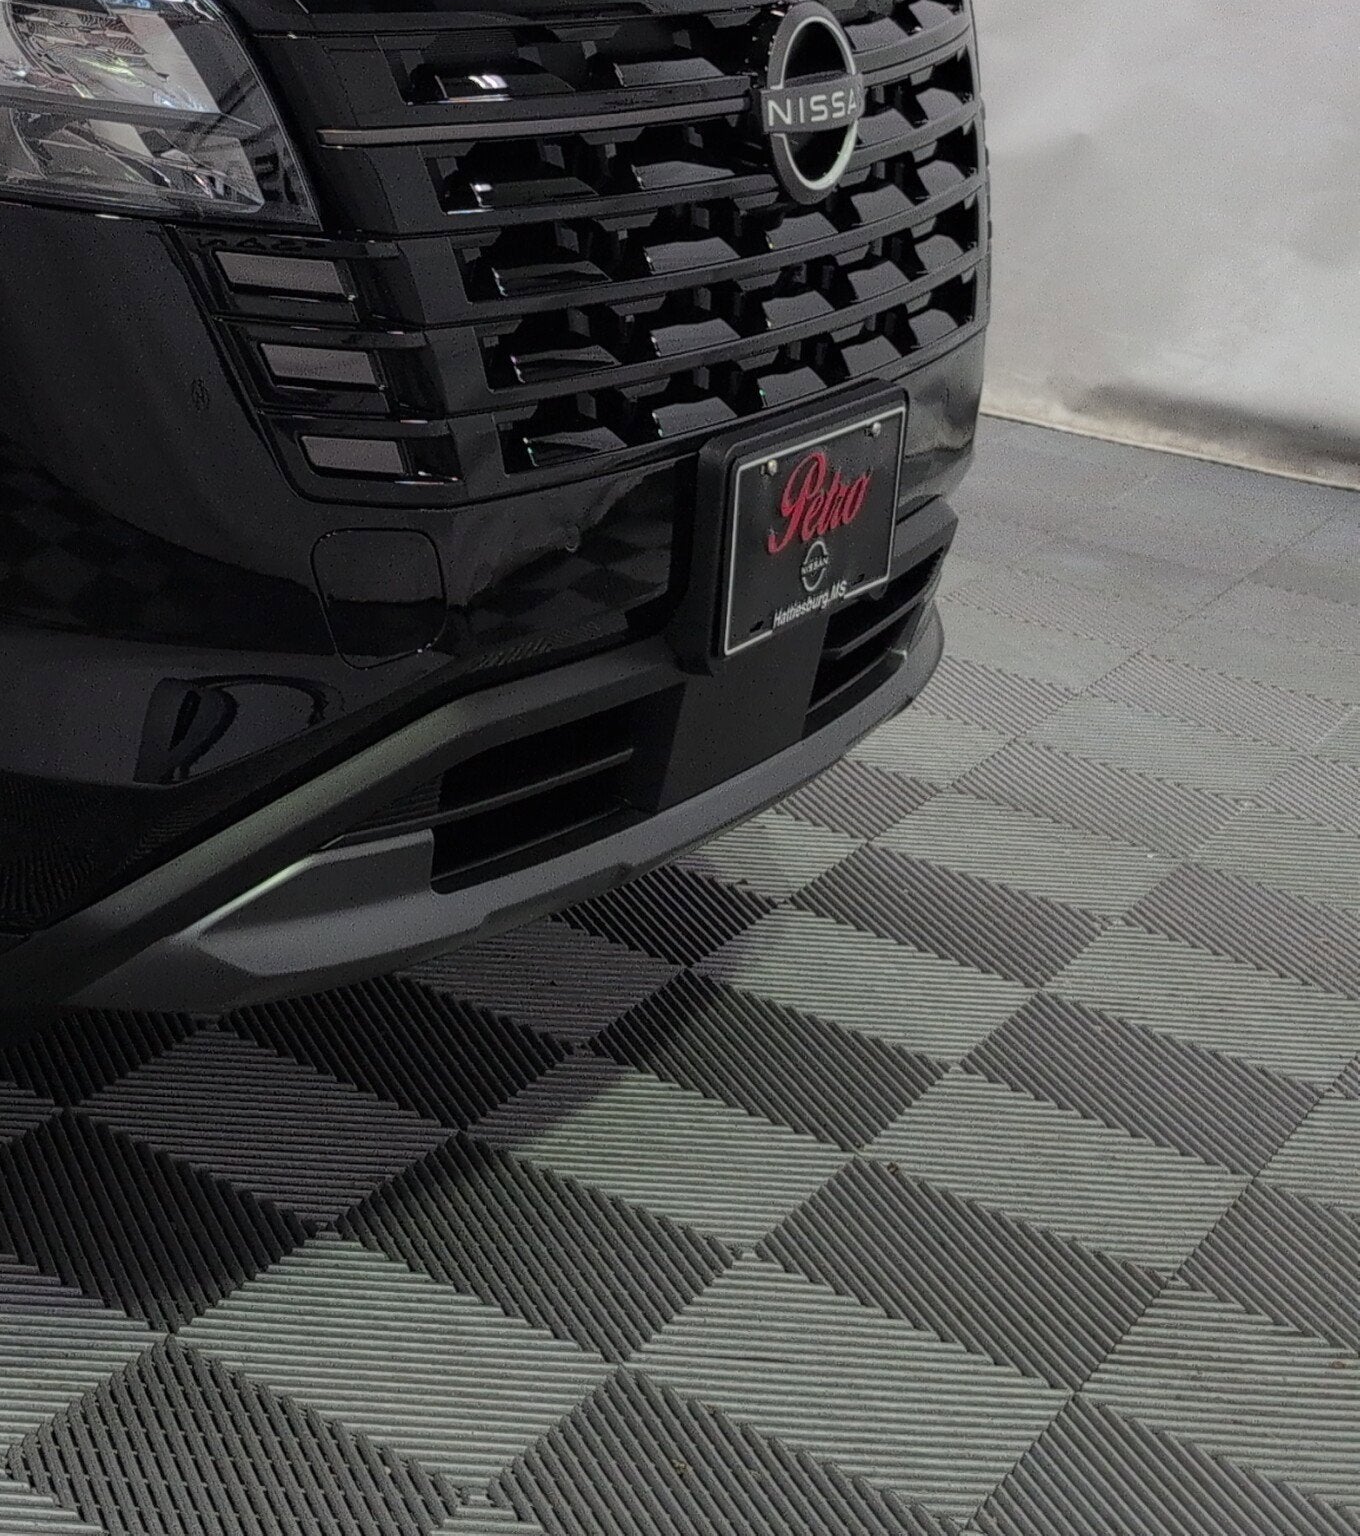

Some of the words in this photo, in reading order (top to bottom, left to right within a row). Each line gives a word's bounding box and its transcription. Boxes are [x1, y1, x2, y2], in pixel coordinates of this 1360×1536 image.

[767, 87, 857, 127] NISSA
[768, 451, 871, 554] Petro
[831, 579, 847, 600] MS
